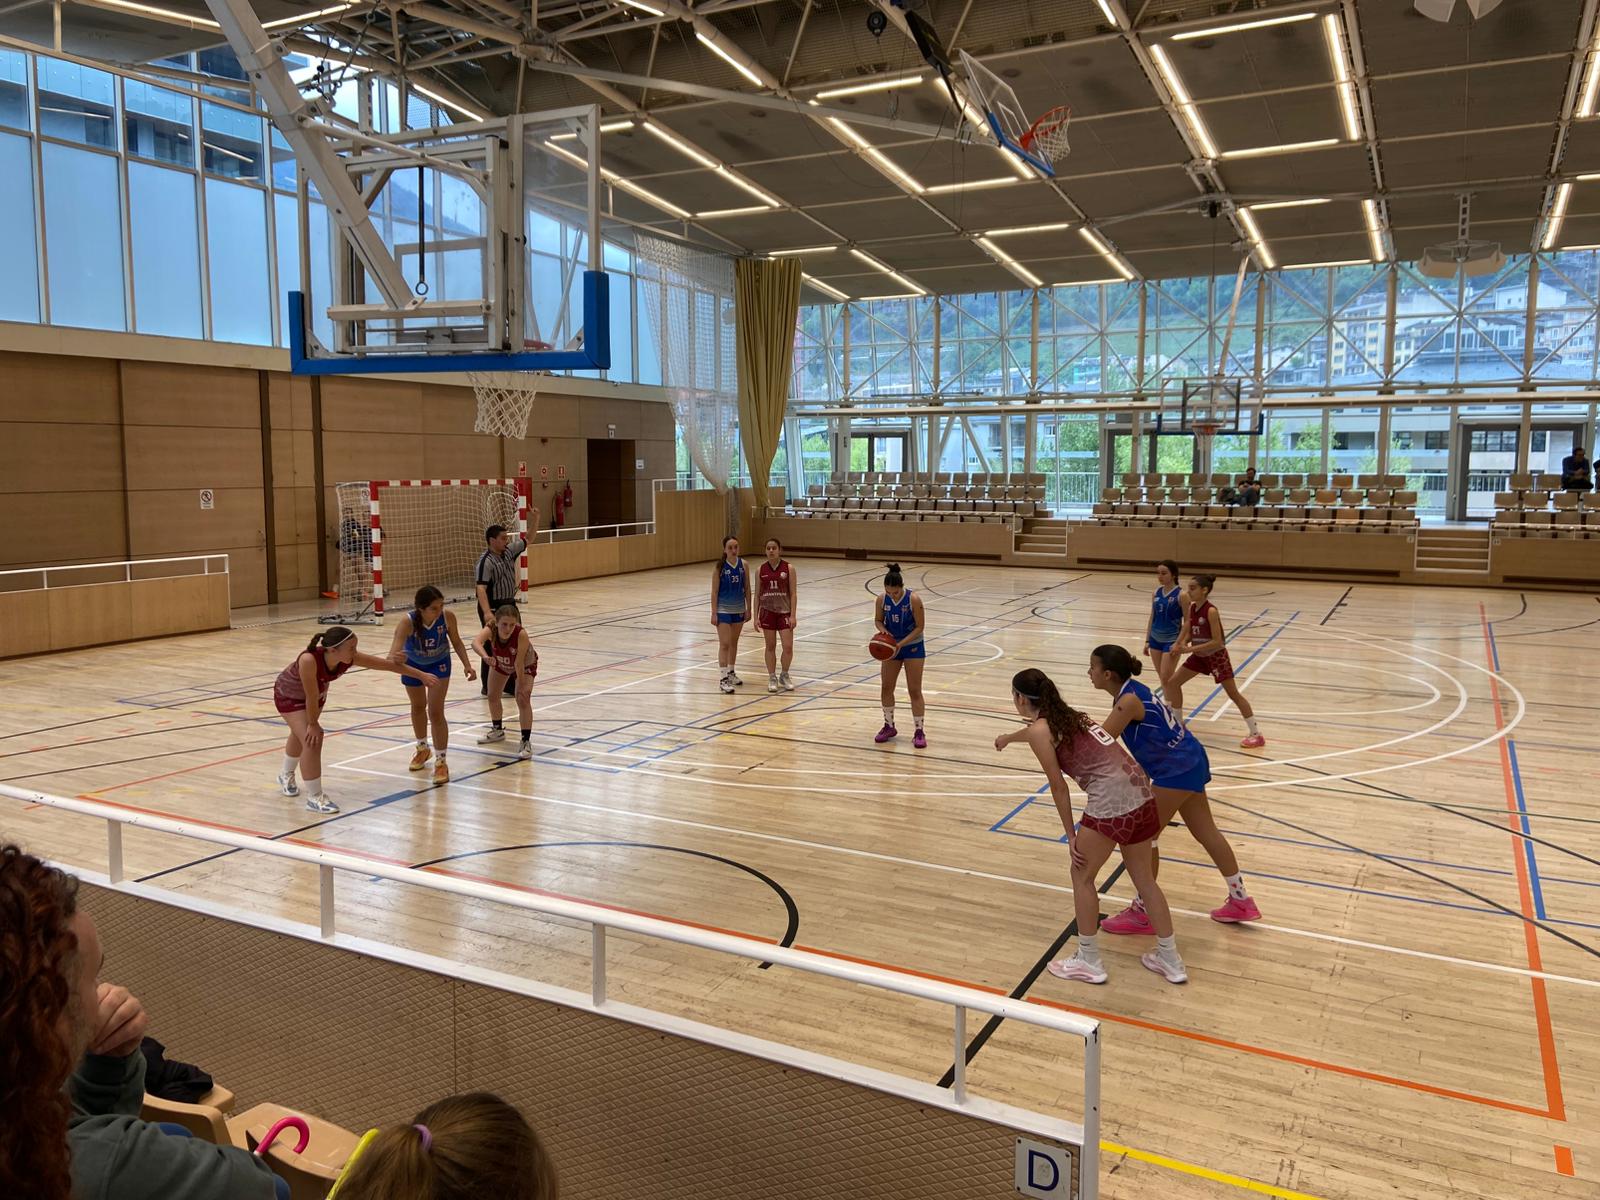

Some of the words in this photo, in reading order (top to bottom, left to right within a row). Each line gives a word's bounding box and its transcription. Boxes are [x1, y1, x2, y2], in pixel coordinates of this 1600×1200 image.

[769, 580, 779, 589] 11
[424, 638, 436, 647] 12
[1027, 1148, 1060, 1192] D
